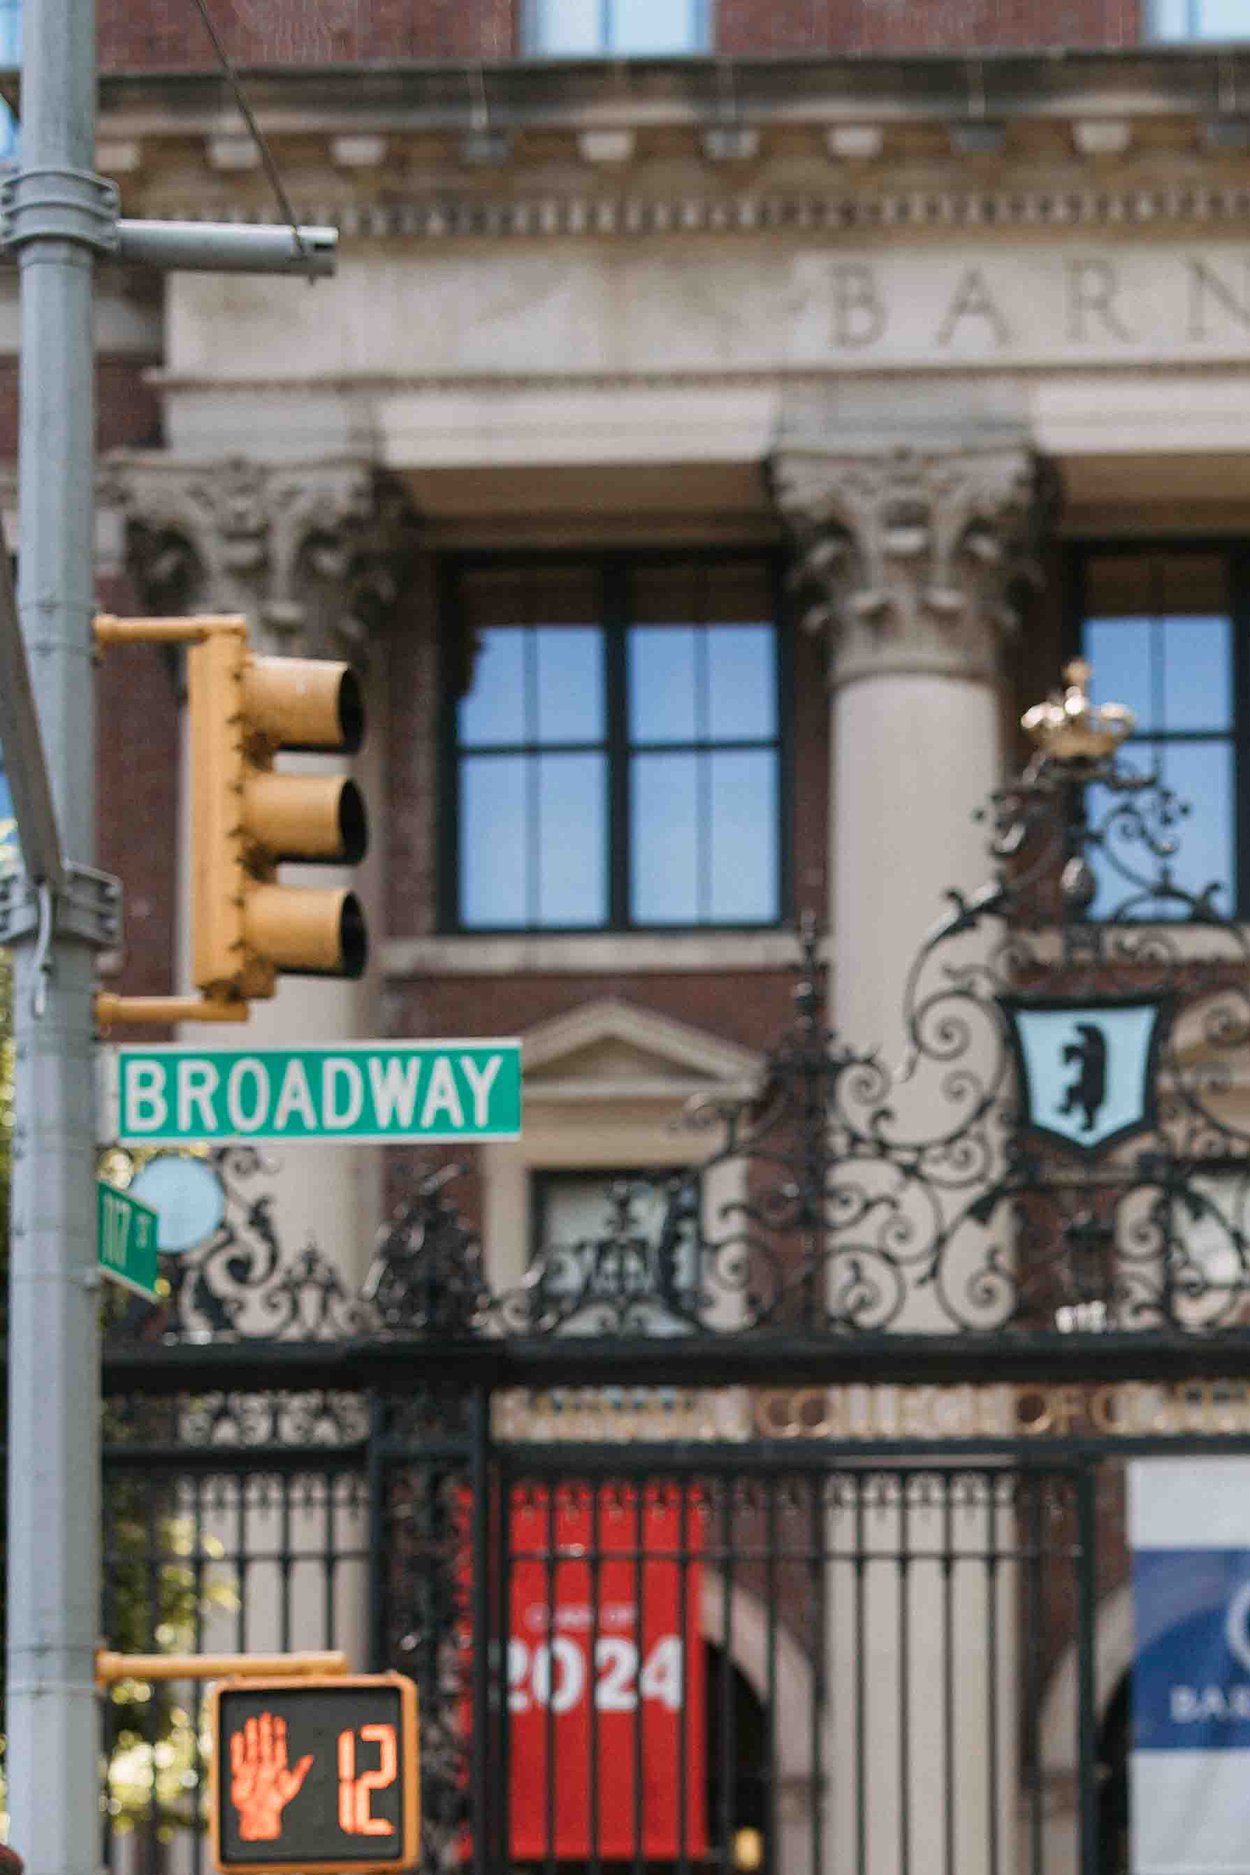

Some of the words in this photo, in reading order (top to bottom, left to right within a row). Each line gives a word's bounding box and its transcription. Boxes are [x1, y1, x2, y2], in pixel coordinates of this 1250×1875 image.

[124, 1055, 503, 1132] BROADWAY
[488, 1635, 684, 1714] 2024
[338, 1723, 398, 1836] 12
